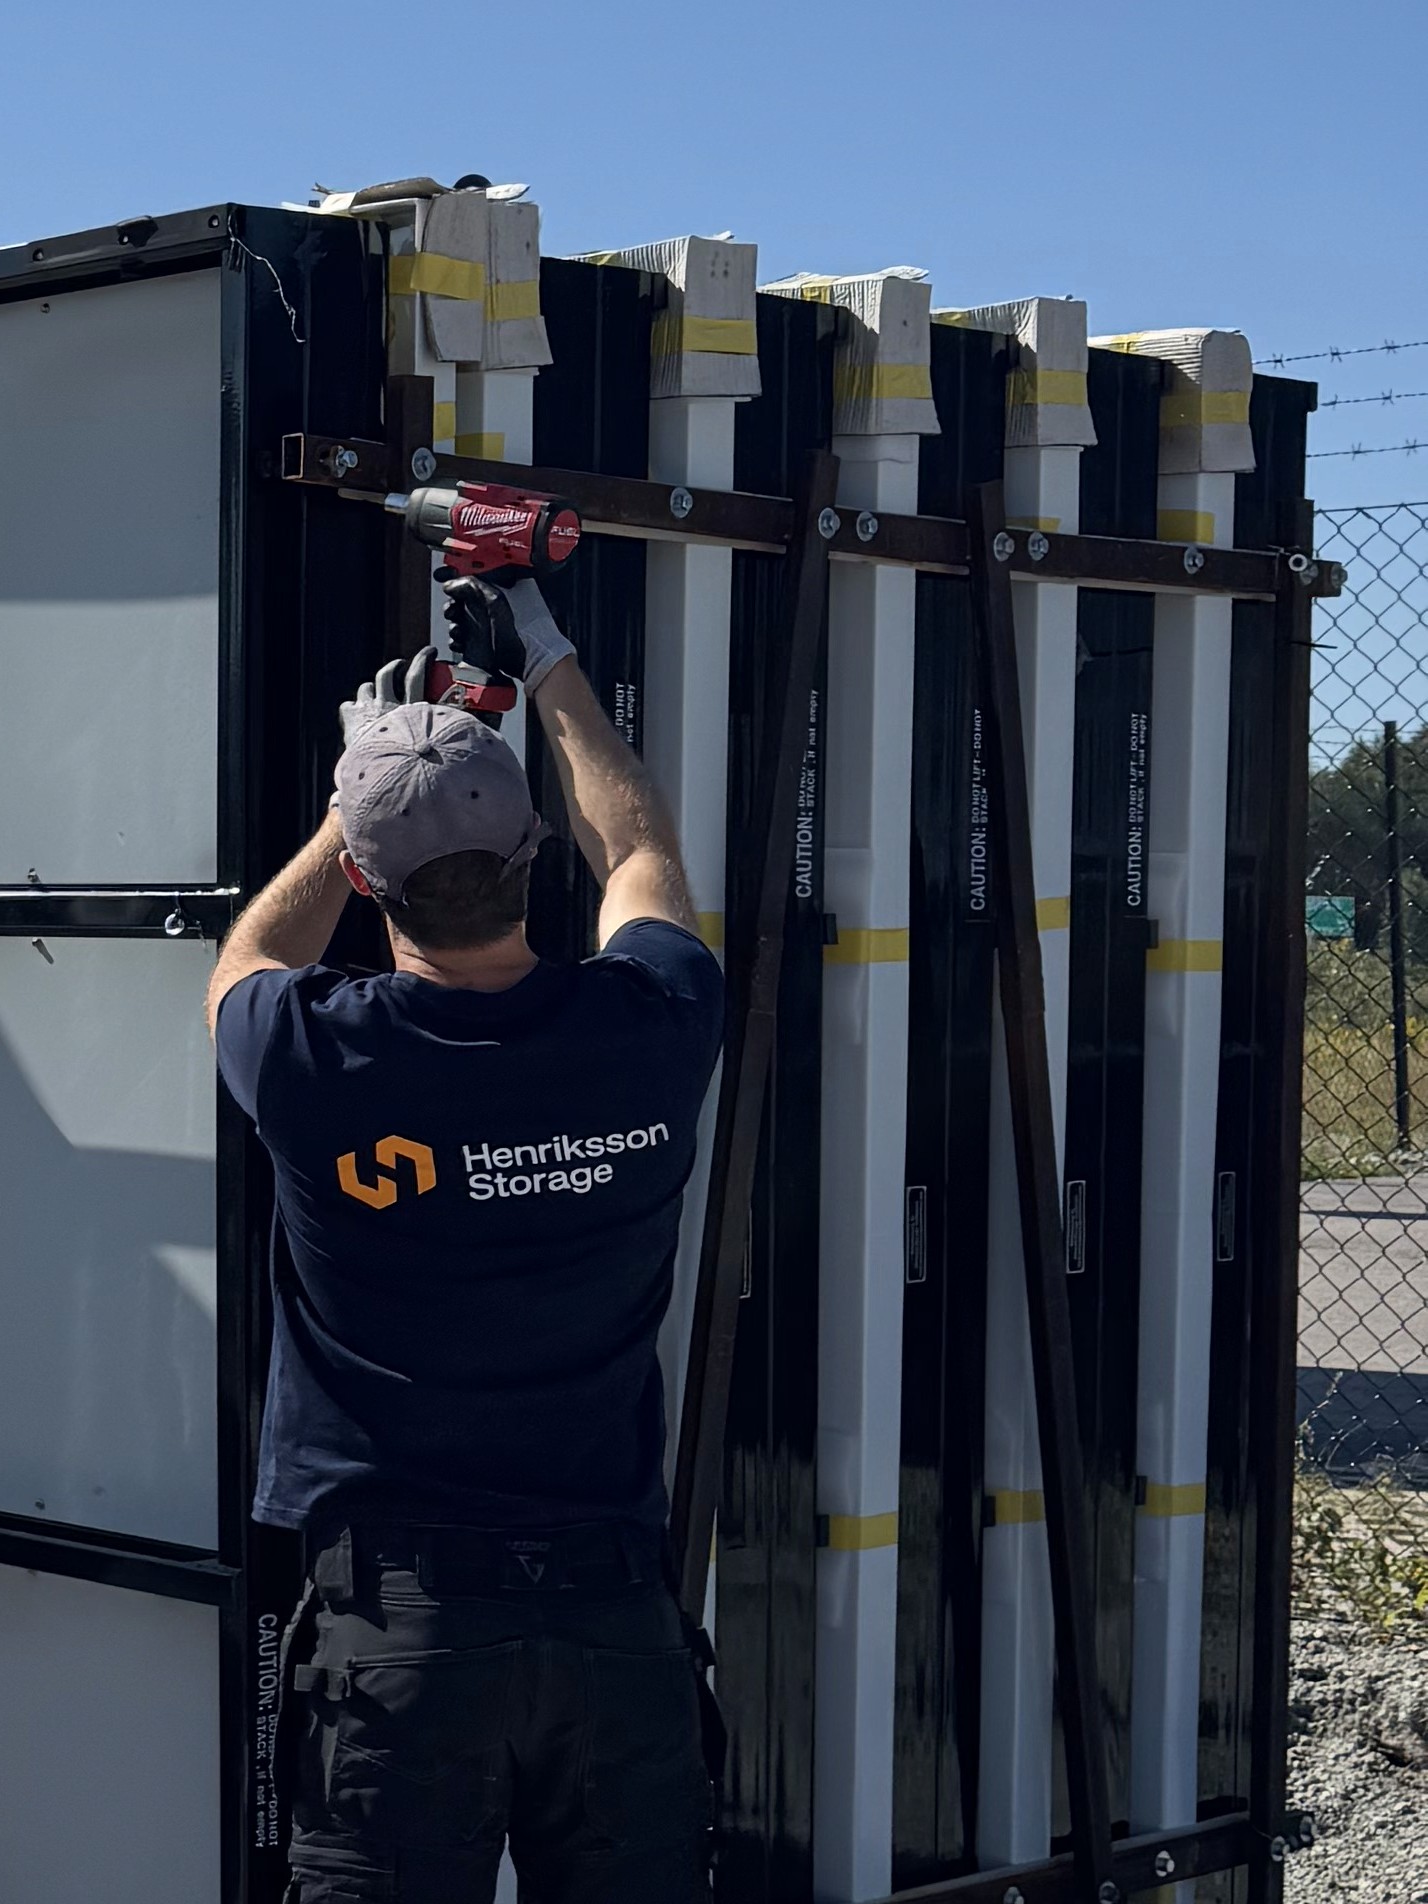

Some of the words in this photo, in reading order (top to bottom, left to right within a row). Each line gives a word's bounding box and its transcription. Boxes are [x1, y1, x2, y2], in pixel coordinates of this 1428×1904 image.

[795, 811, 813, 898] CAUTION:
[970, 827, 986, 911] CAUTION:
[1127, 827, 1142, 906] CAUTION:
[462, 1123, 669, 1172] Henriksson
[469, 1164, 613, 1200] Storage
[258, 1614, 278, 1711] CAUTION:
